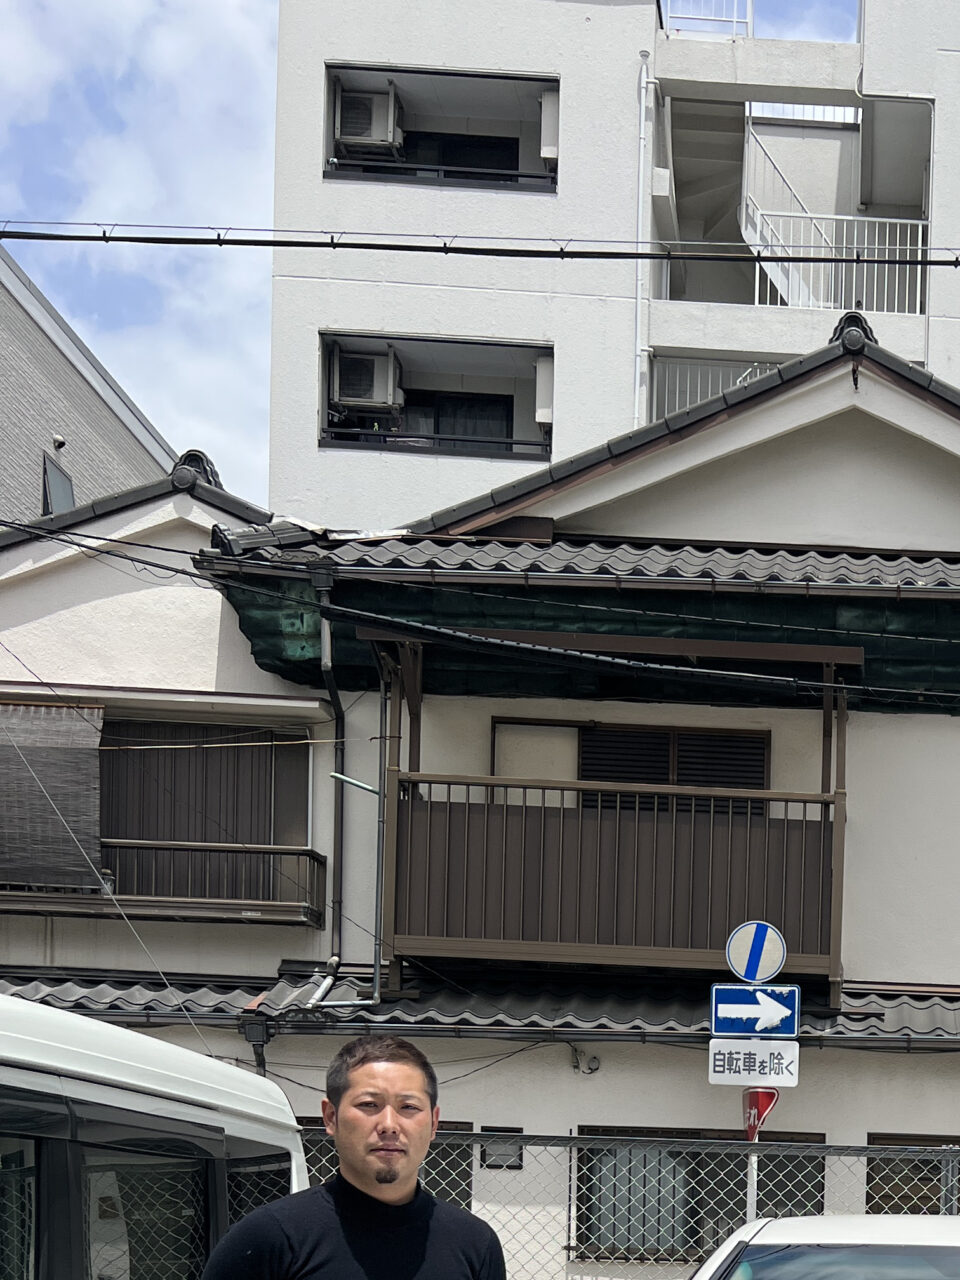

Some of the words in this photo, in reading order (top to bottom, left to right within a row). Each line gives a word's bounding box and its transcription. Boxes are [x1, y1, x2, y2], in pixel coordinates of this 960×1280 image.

[712, 1050, 795, 1076] 自転車を除く
